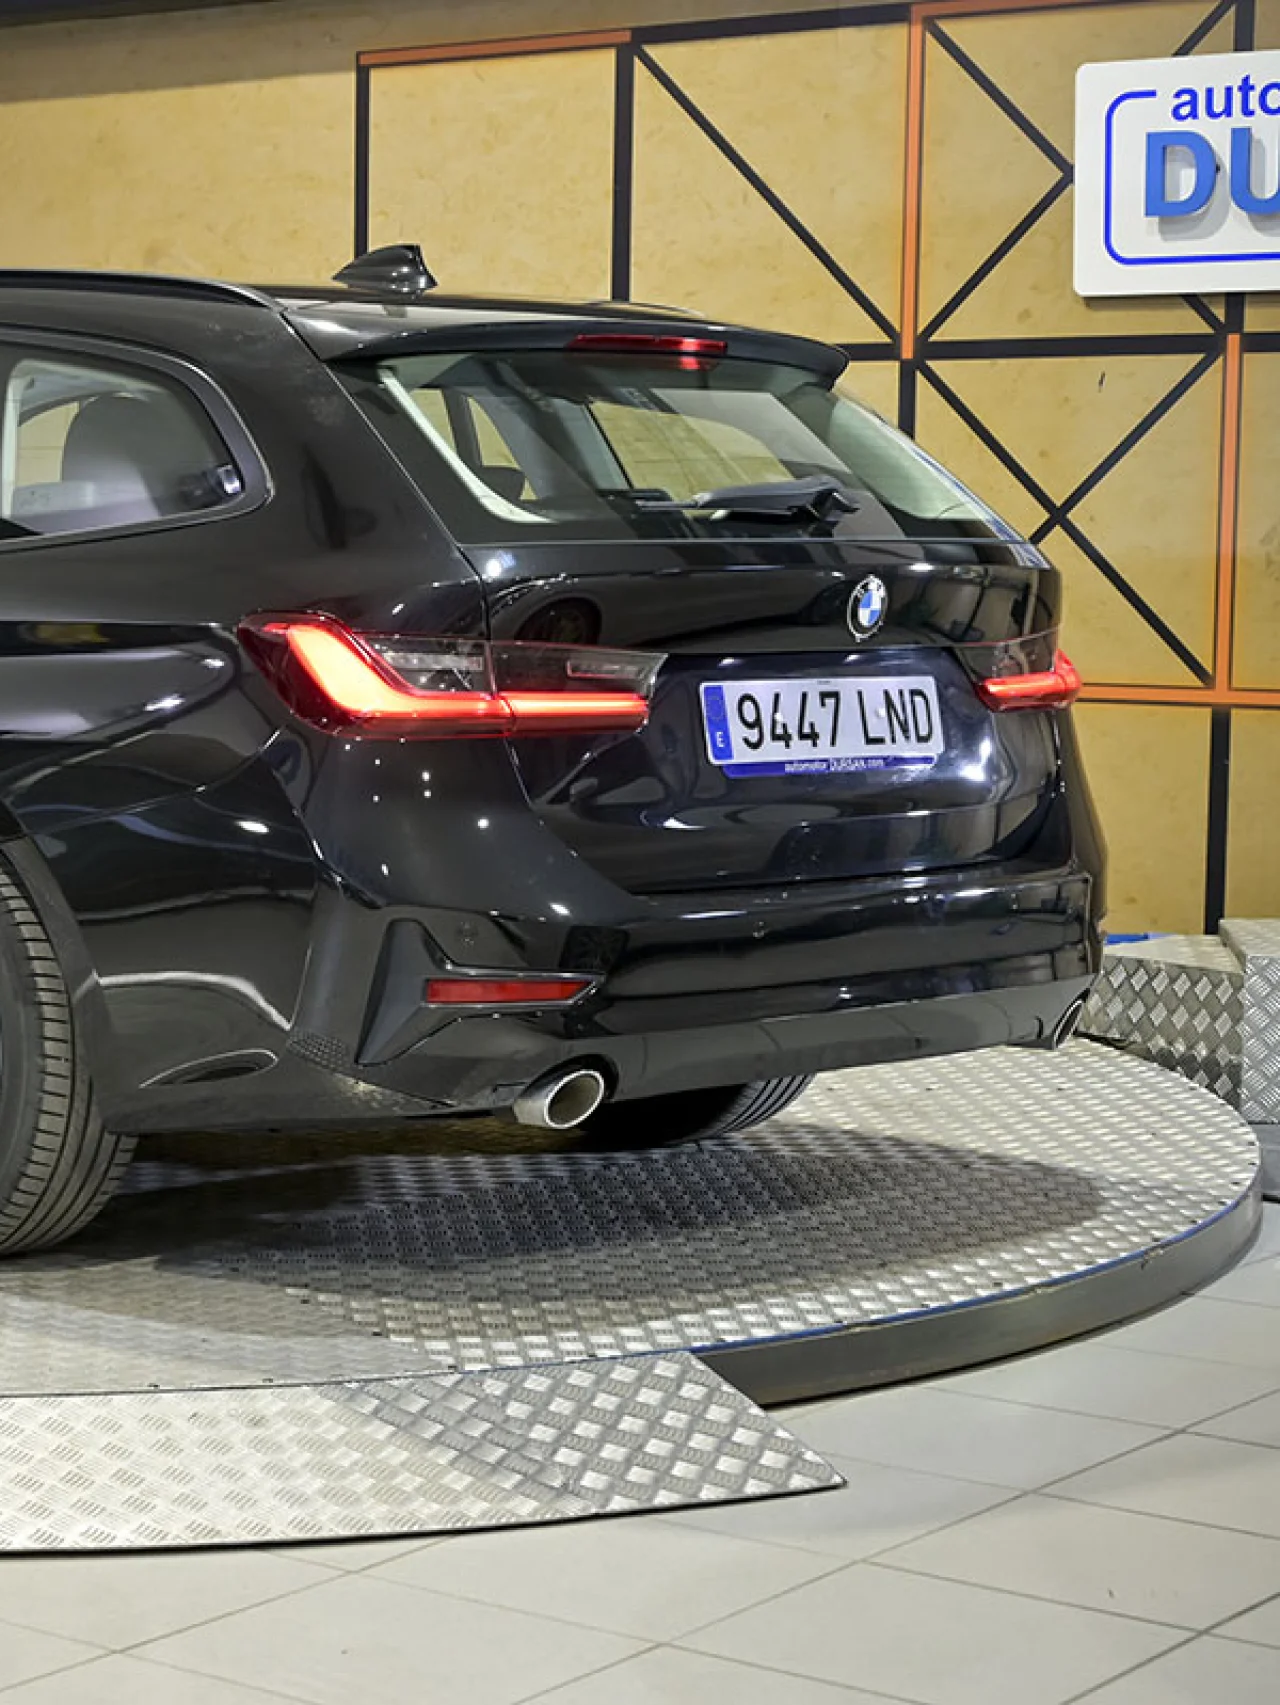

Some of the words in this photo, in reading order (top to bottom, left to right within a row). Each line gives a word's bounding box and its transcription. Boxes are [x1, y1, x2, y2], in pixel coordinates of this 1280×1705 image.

[716, 731, 724, 748] E
[737, 691, 841, 751] 9447
[857, 688, 934, 745] LND
